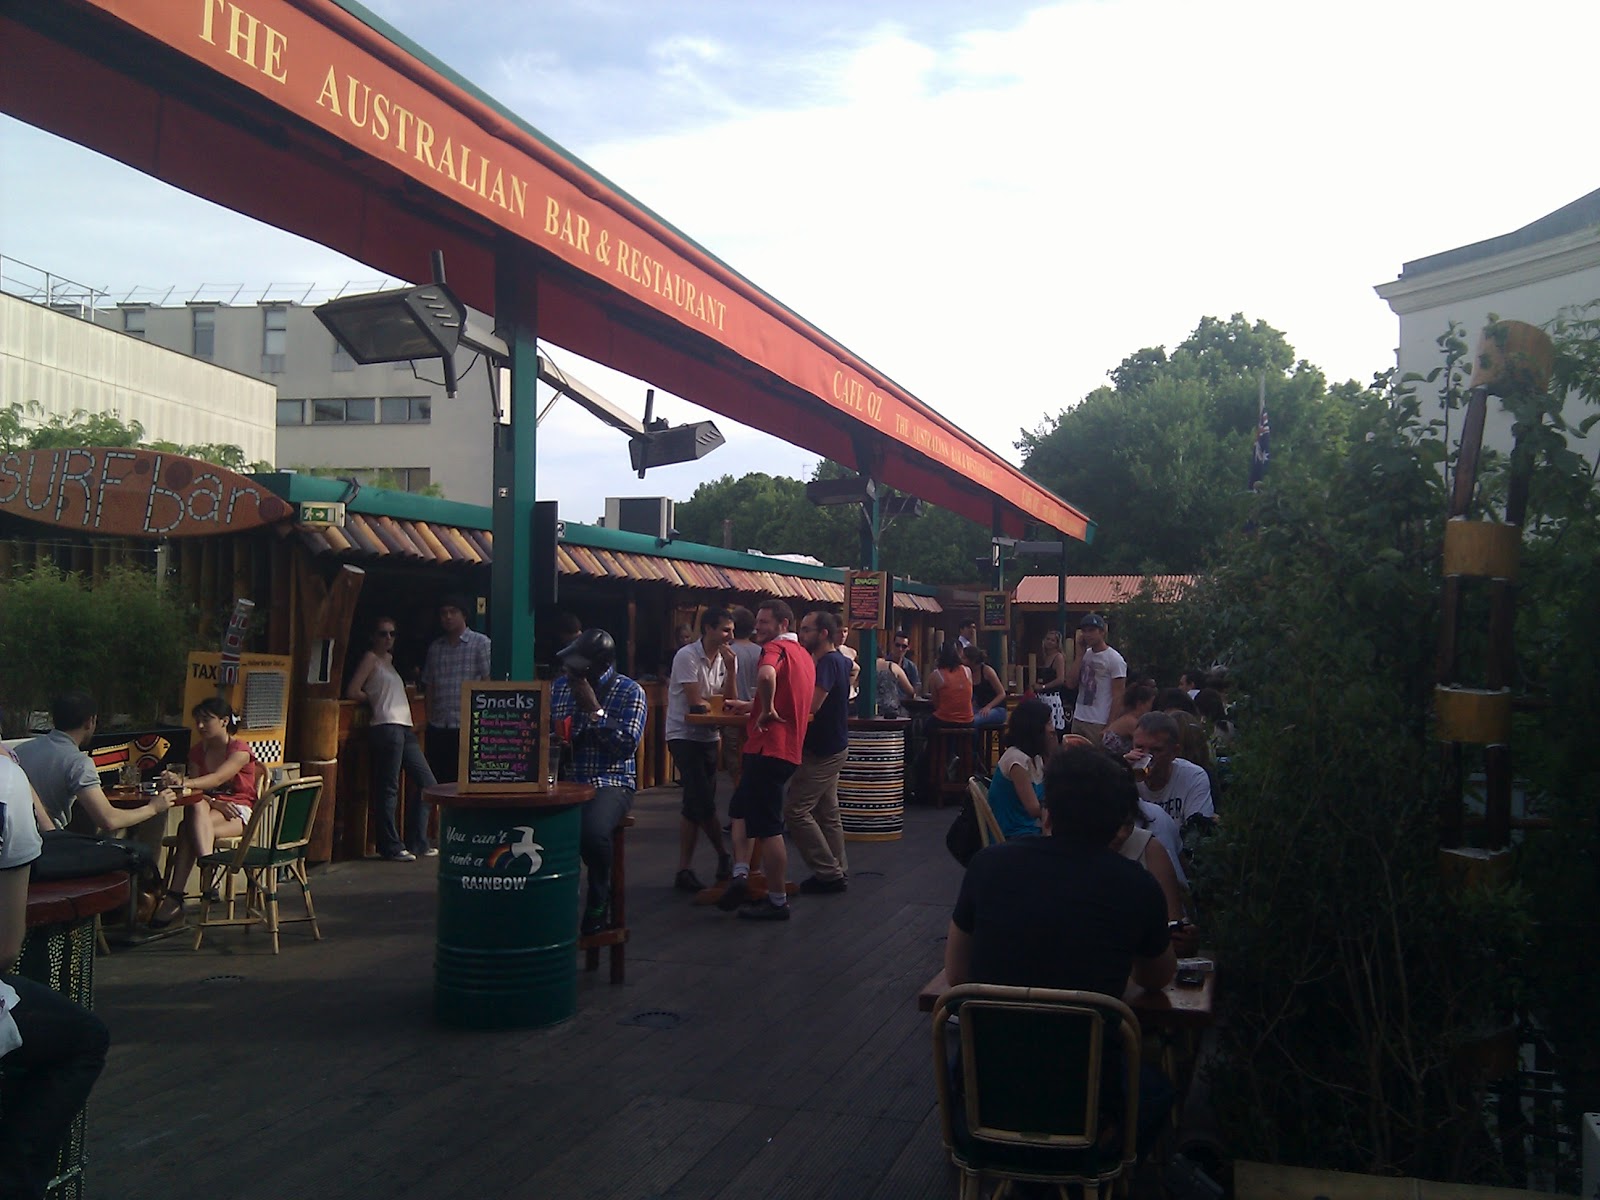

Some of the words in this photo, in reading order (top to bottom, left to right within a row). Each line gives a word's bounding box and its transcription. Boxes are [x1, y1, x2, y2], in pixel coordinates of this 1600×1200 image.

[198, 0, 288, 84] THE
[316, 65, 528, 219] AUSTRALIAN
[544, 196, 591, 255] BAR
[596, 229, 611, 266] &
[616, 239, 727, 331] RESTAURANT
[833, 370, 864, 412] CAFE
[867, 391, 883, 422] OZ
[895, 413, 910, 438] THE
[0, 449, 137, 528] SURF
[143, 454, 261, 533] bar
[192, 663, 217, 680] TAX
[475, 692, 535, 709] Snacks
[446, 826, 466, 843] You
[472, 830, 509, 844] can't
[449, 852, 473, 866] sink
[473, 858, 485, 867] a
[461, 876, 527, 890] RAINBOW
